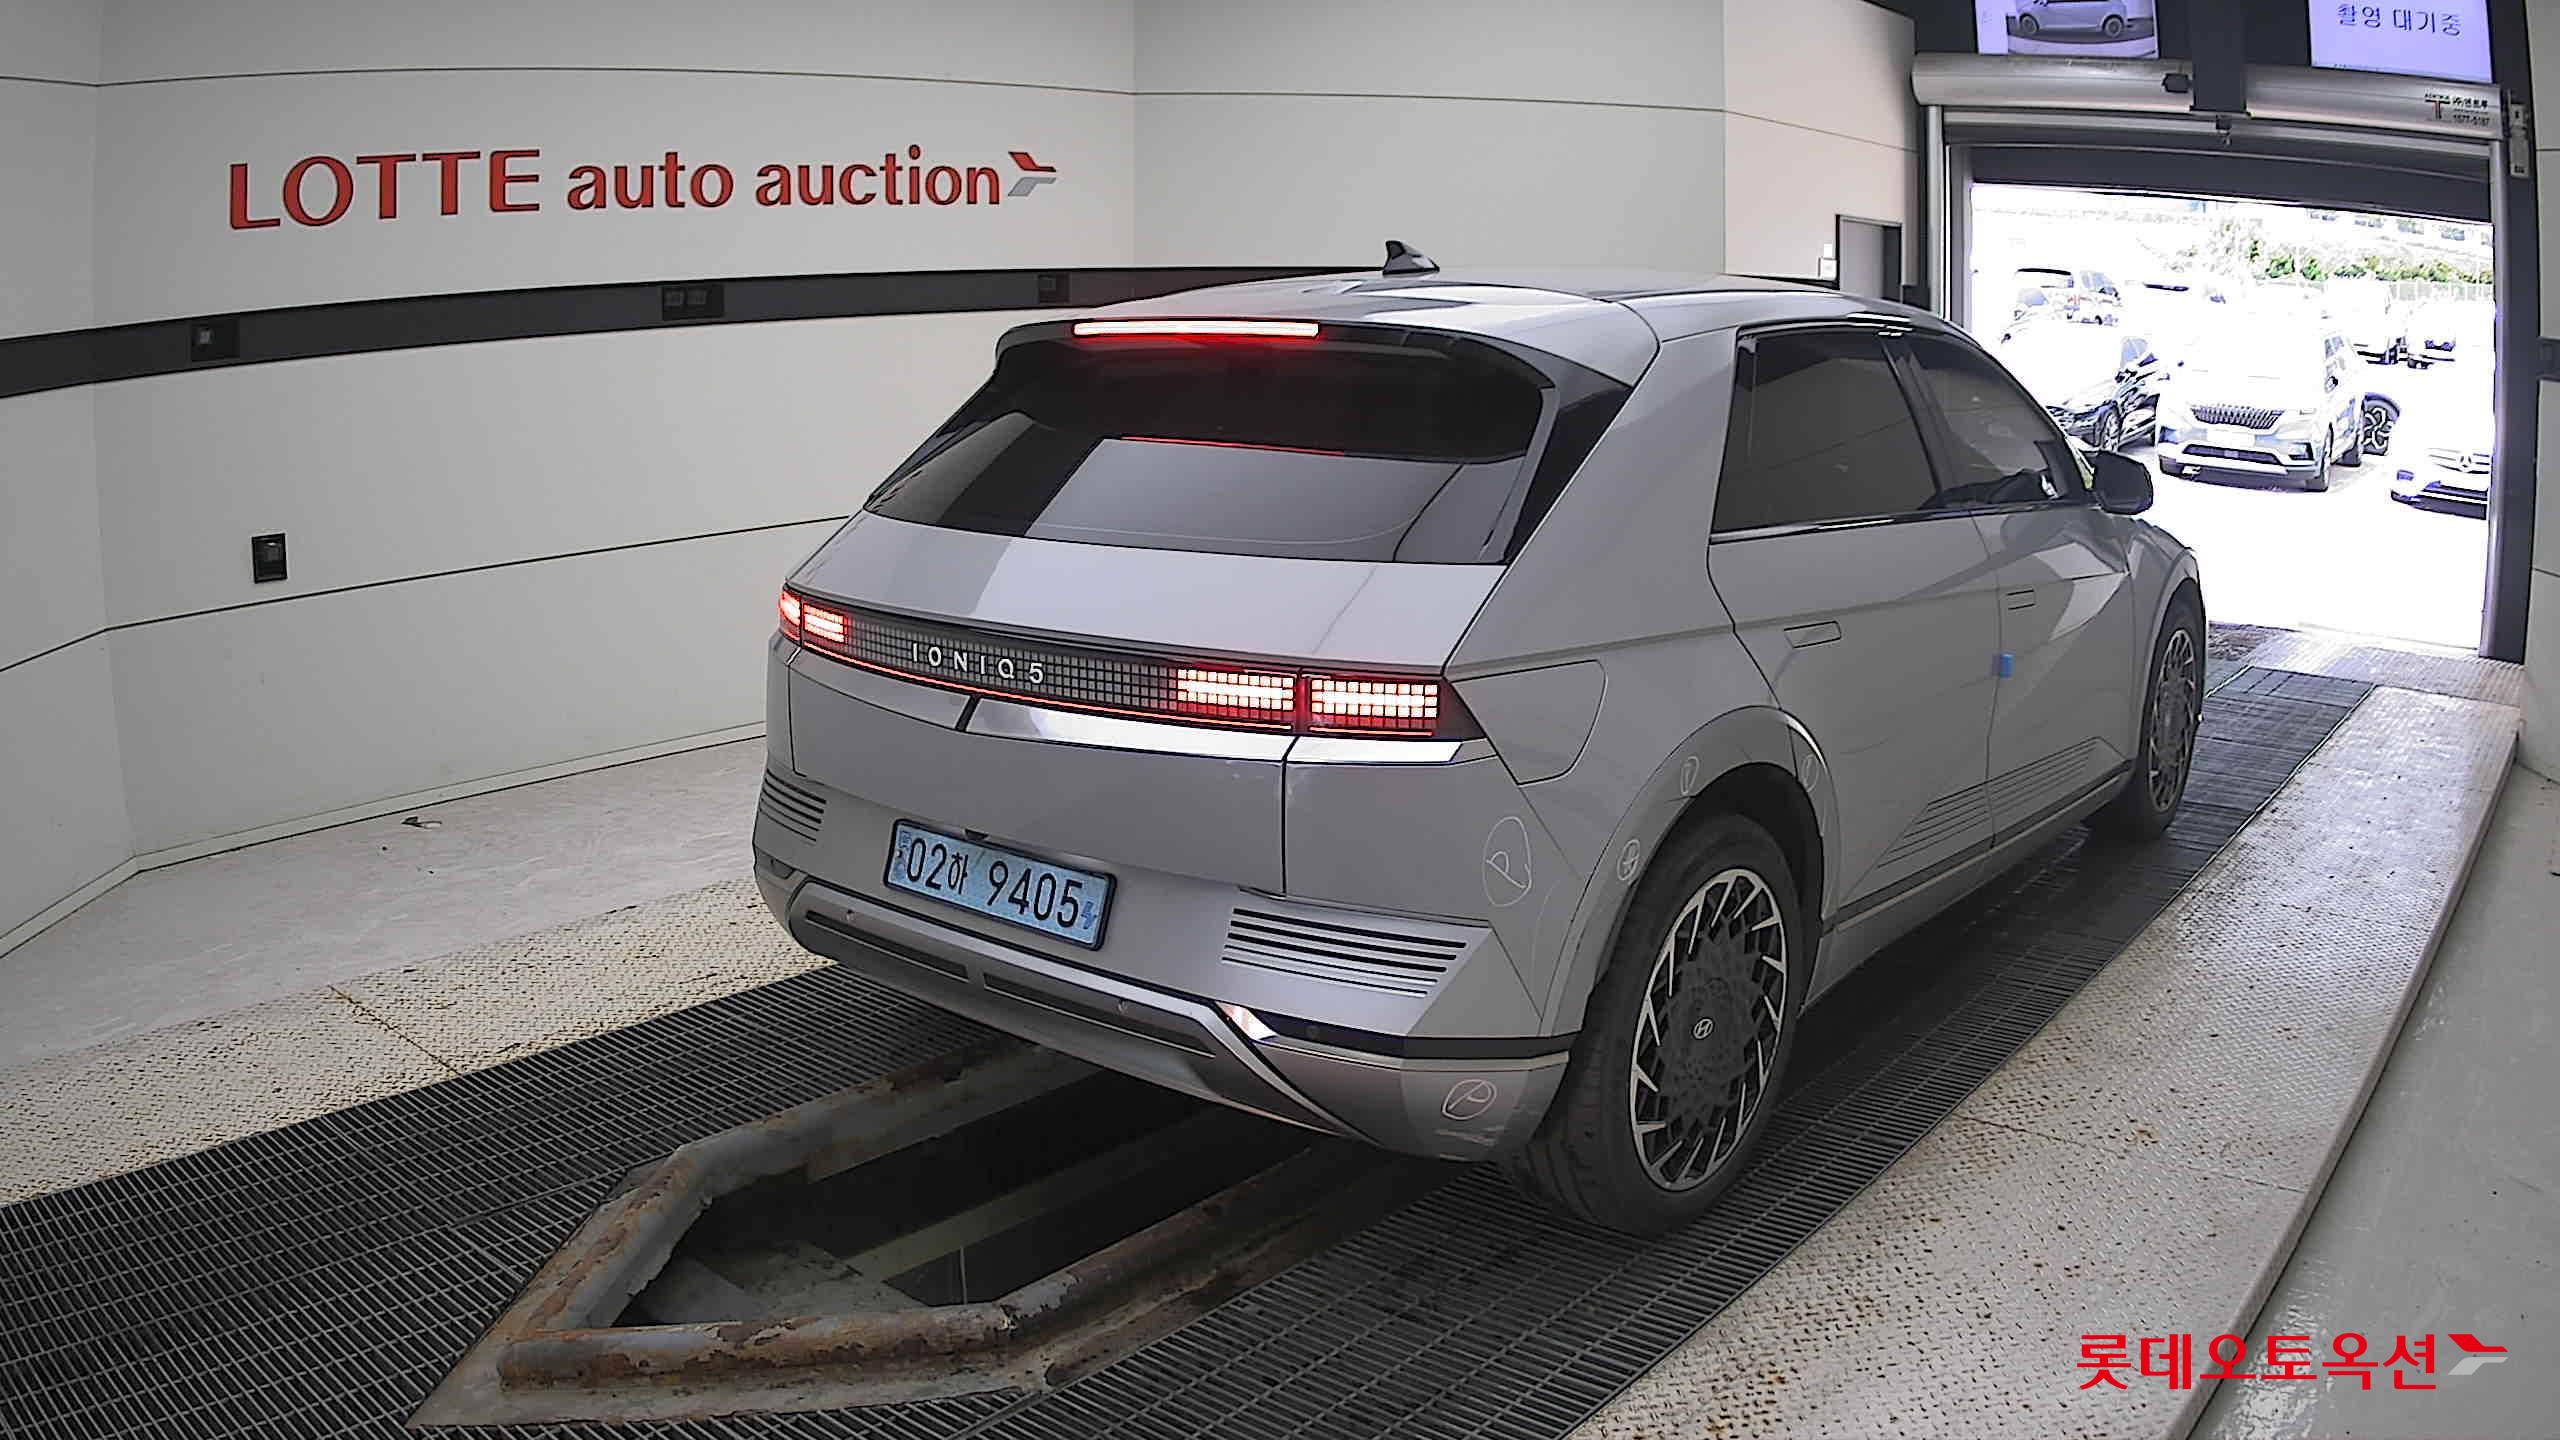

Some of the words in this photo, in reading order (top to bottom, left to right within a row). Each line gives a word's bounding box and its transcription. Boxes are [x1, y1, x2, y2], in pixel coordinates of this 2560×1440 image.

[2393, 8, 2462, 36] 대기중
[229, 149, 541, 231] LOTTE
[567, 151, 734, 209] auto
[755, 144, 1002, 207] auction
[912, 643, 1015, 679] IONIQ
[1029, 662, 1044, 684] 5
[907, 838, 969, 894] 02하
[987, 861, 1083, 928] 9405
